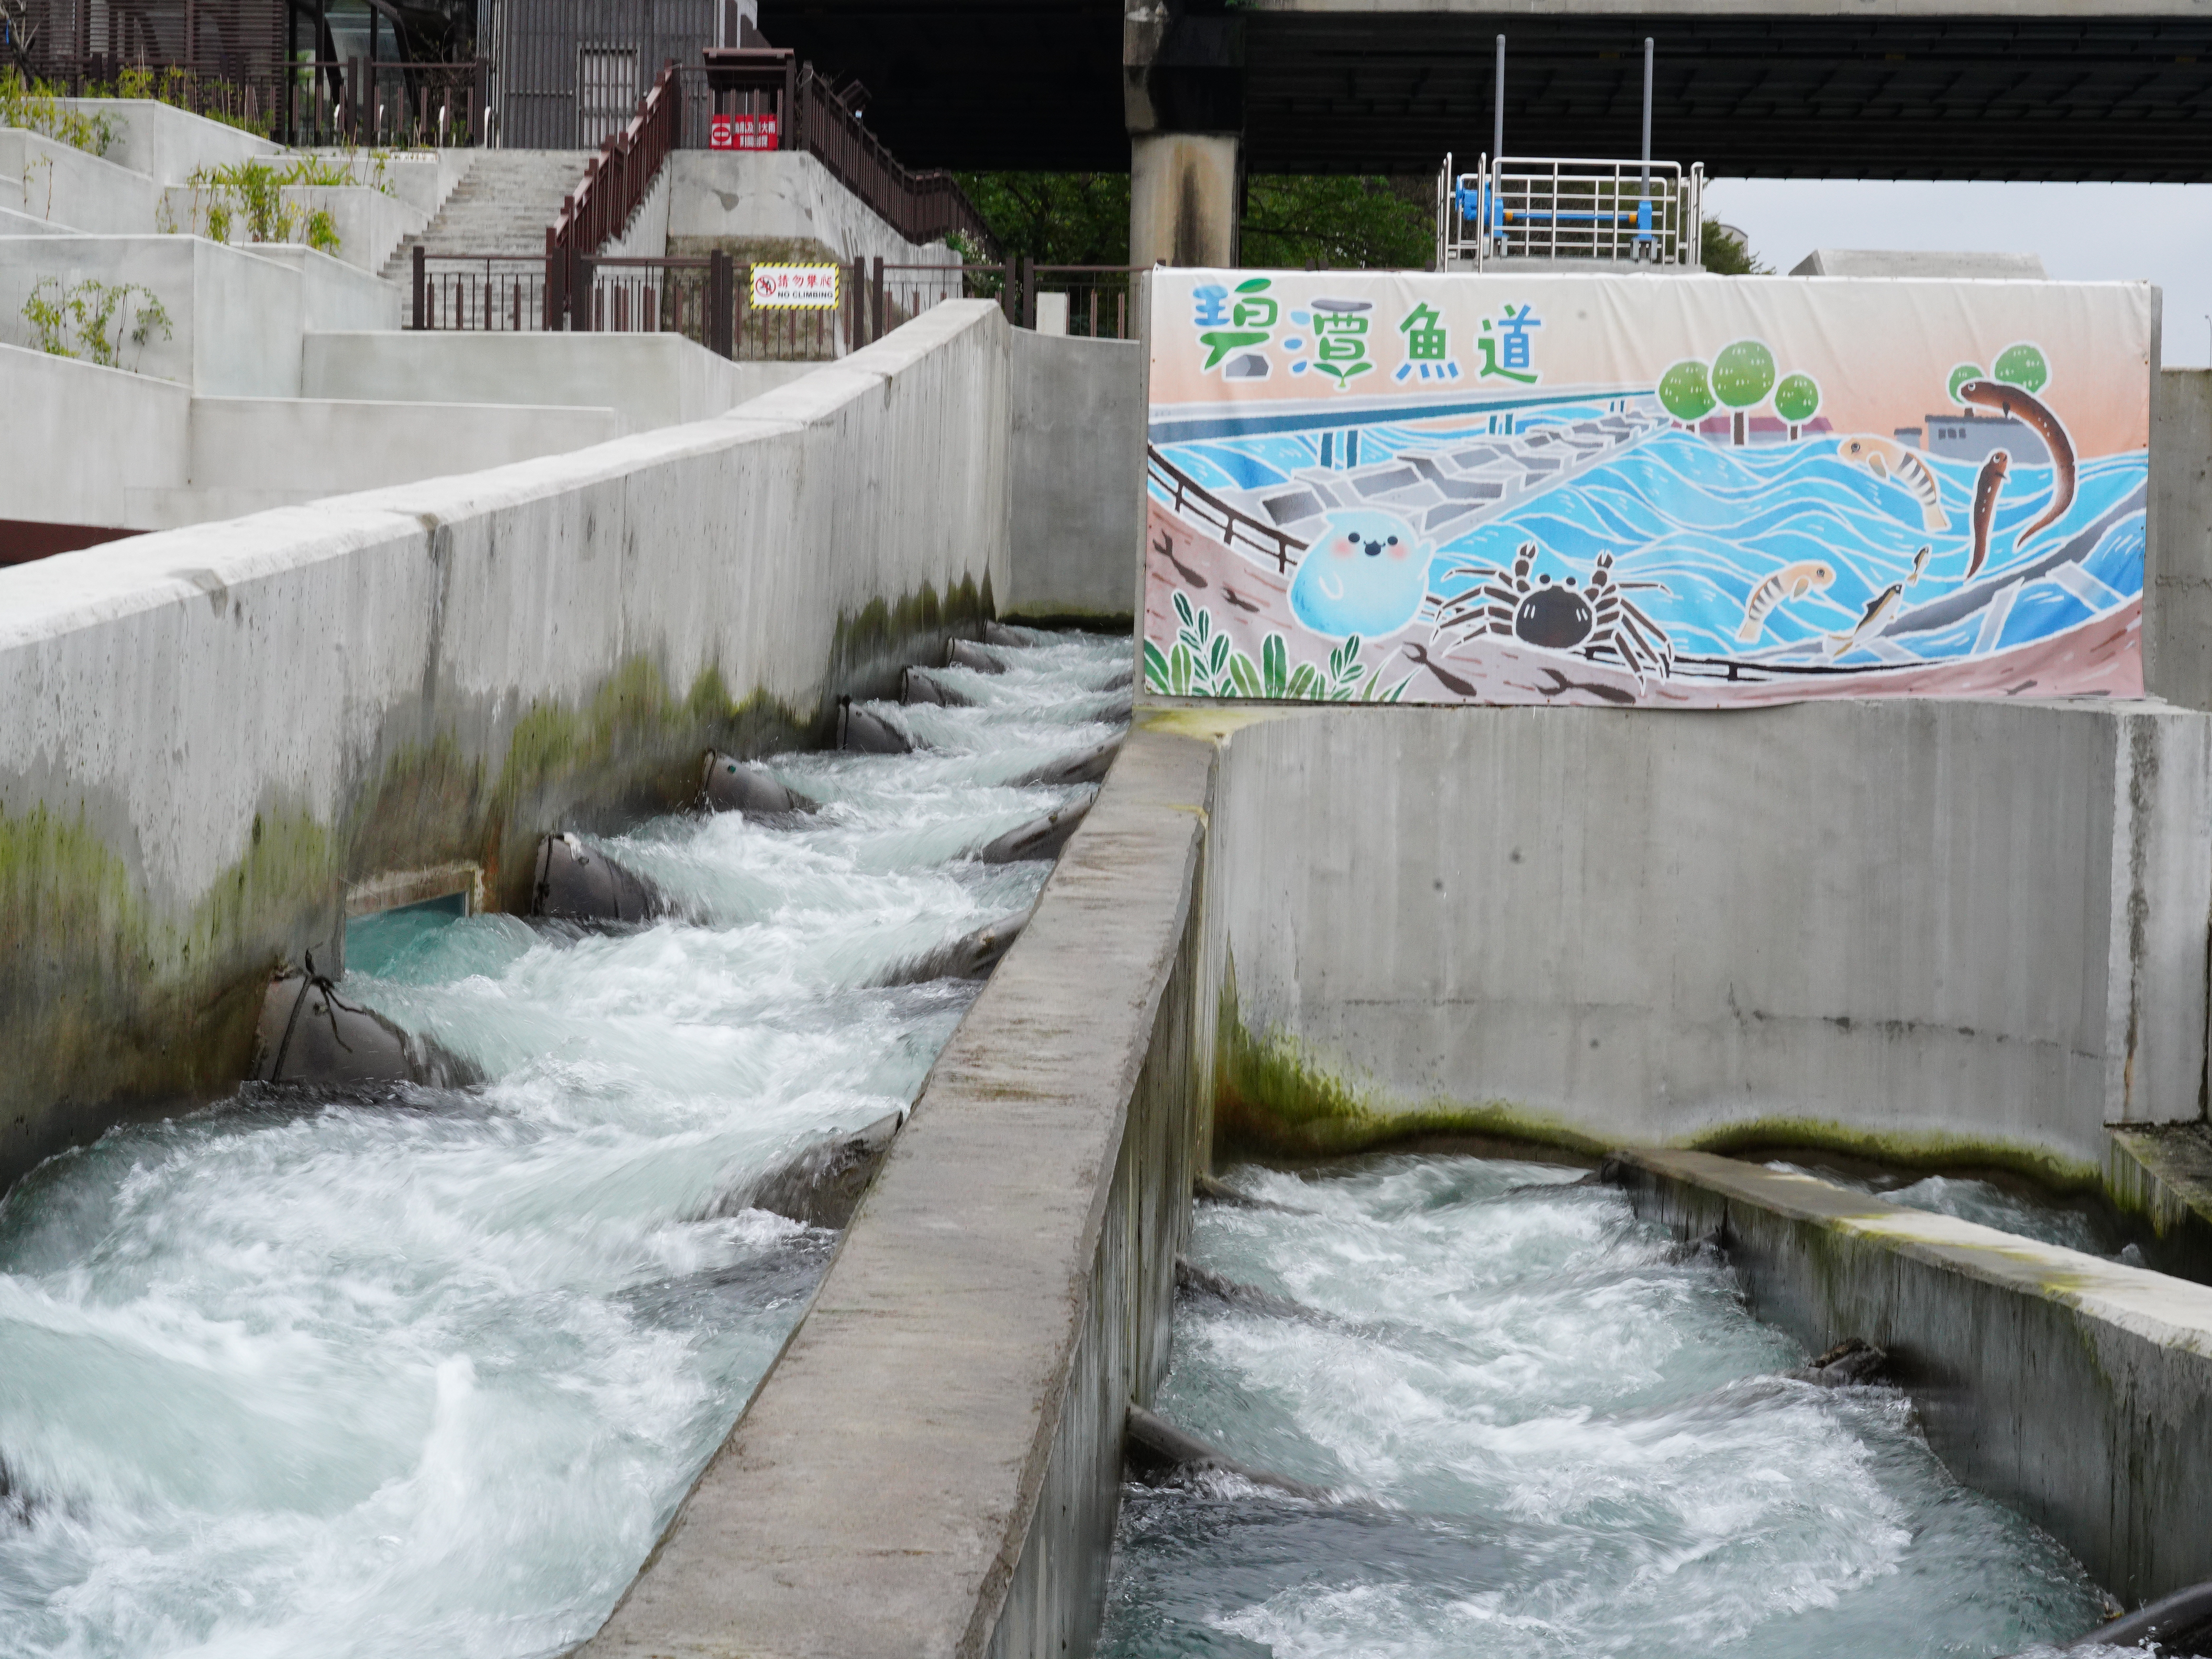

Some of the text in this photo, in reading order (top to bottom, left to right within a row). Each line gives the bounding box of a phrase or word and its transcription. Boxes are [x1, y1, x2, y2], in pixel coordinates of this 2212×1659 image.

[778, 273, 832, 289] 請勿攀爬
[778, 291, 833, 299] NO CLIMBING
[1192, 278, 1542, 389] 碧潭魚道
